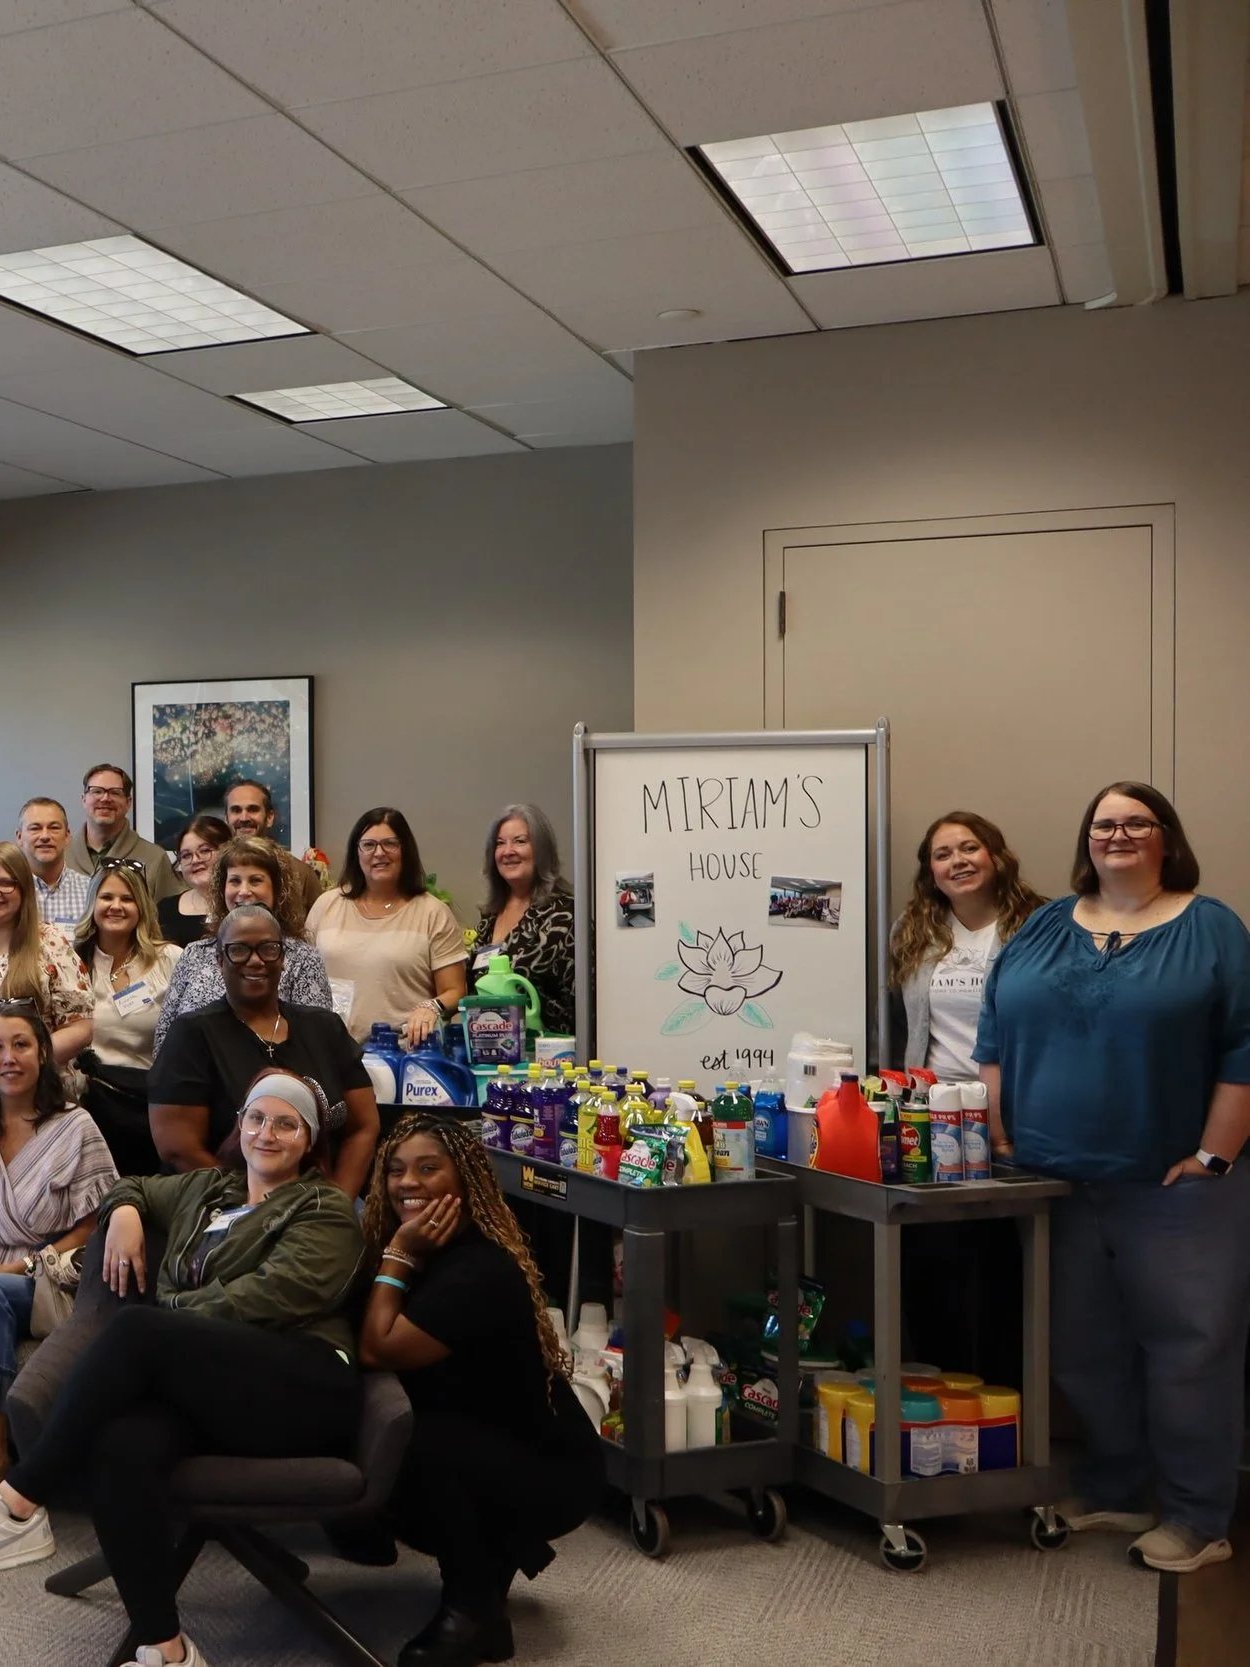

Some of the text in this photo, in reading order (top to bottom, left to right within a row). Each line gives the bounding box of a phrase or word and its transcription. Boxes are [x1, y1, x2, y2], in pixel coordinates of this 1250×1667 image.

[643, 774, 824, 834] MIRIAM'S
[689, 851, 763, 881] HOUSE
[470, 1020, 512, 1033] Cascade
[700, 1048, 774, 1071] est 1994
[406, 1083, 438, 1097] Purex
[621, 1150, 656, 1171] ascade
